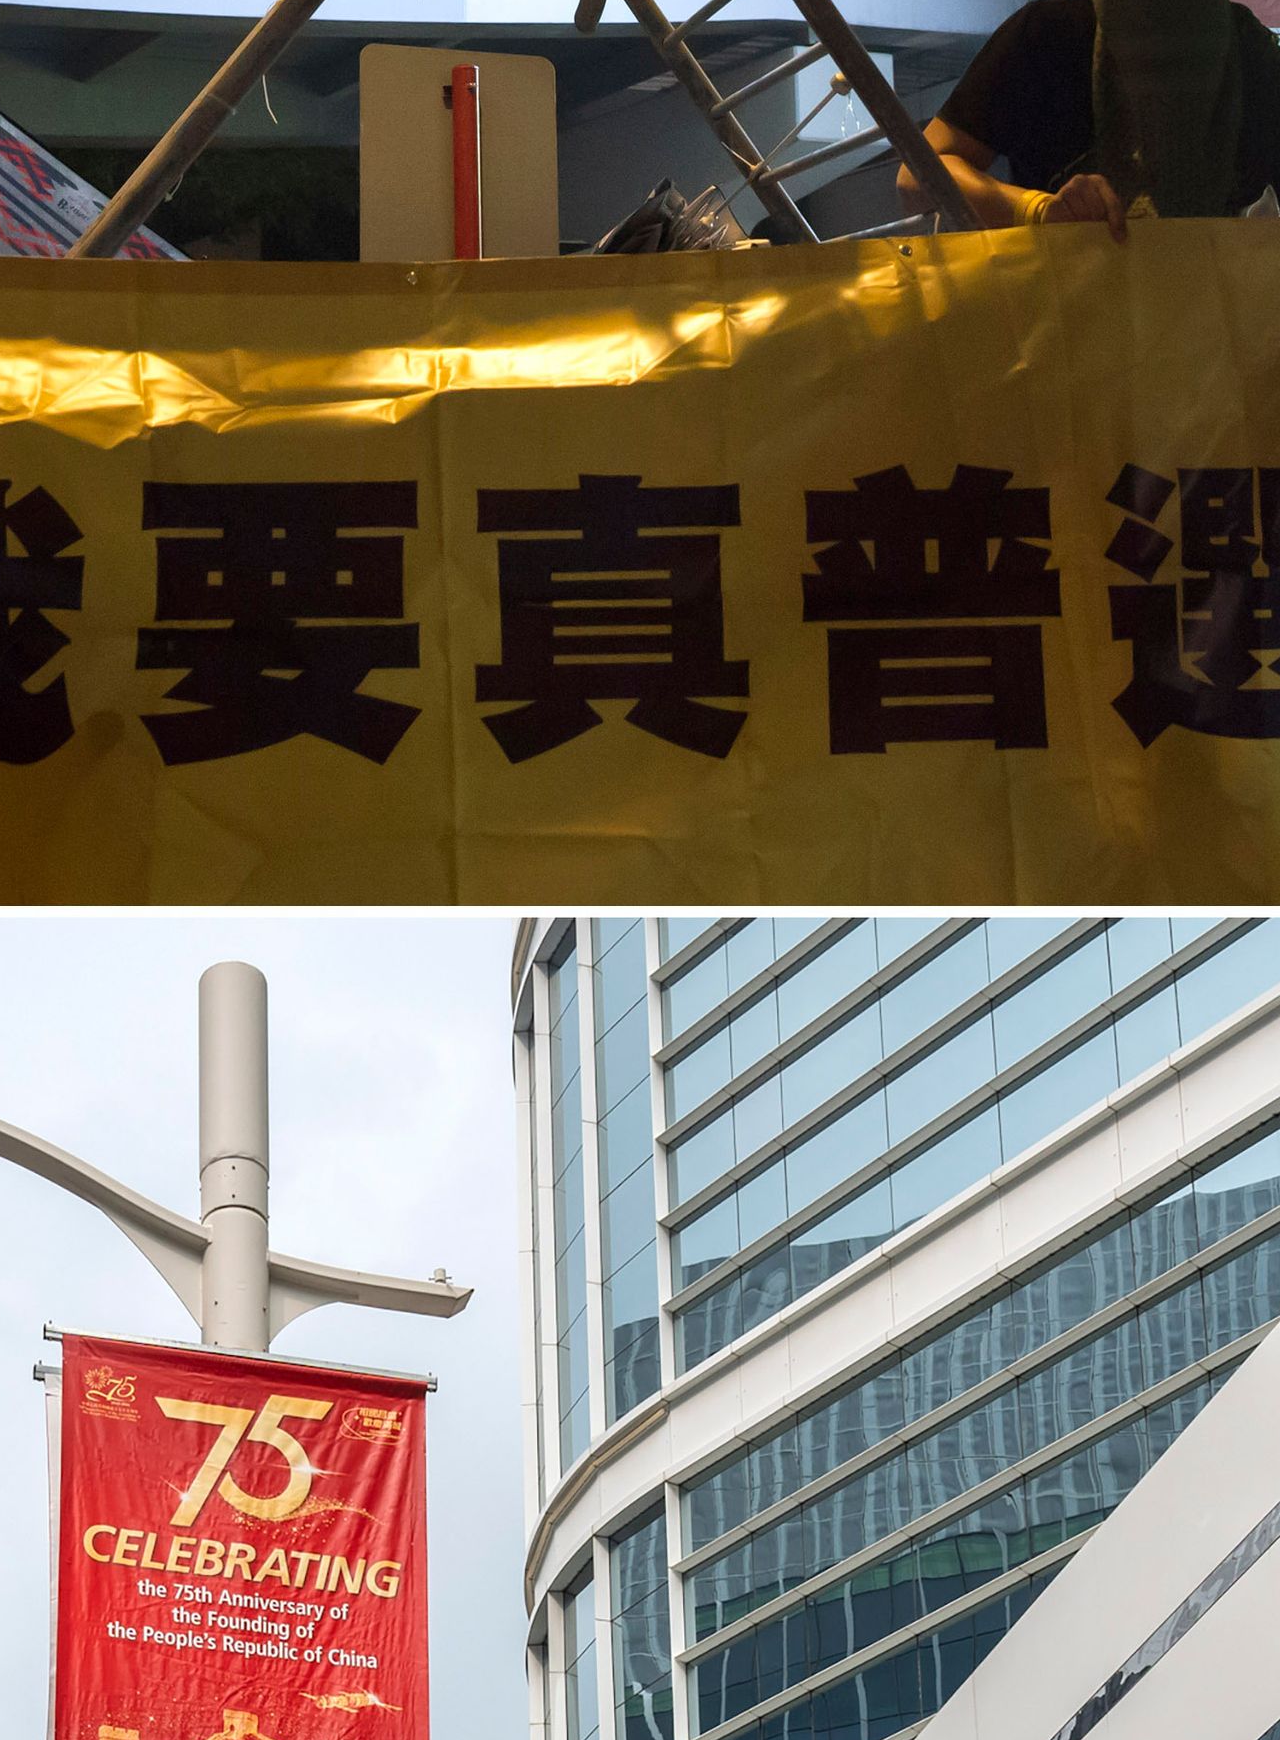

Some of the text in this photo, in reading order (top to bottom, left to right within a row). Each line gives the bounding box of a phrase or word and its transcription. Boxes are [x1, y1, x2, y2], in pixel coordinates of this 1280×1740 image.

[155, 1395, 334, 1527] 75
[82, 1523, 402, 1599] CELEBRATING
[137, 1579, 349, 1622] the 75th Anniversary of
[172, 1606, 315, 1641] the Founding of
[107, 1620, 137, 1641] the
[222, 1635, 298, 1660] Republic
[304, 1646, 322, 1664] of
[328, 1648, 378, 1670] China
